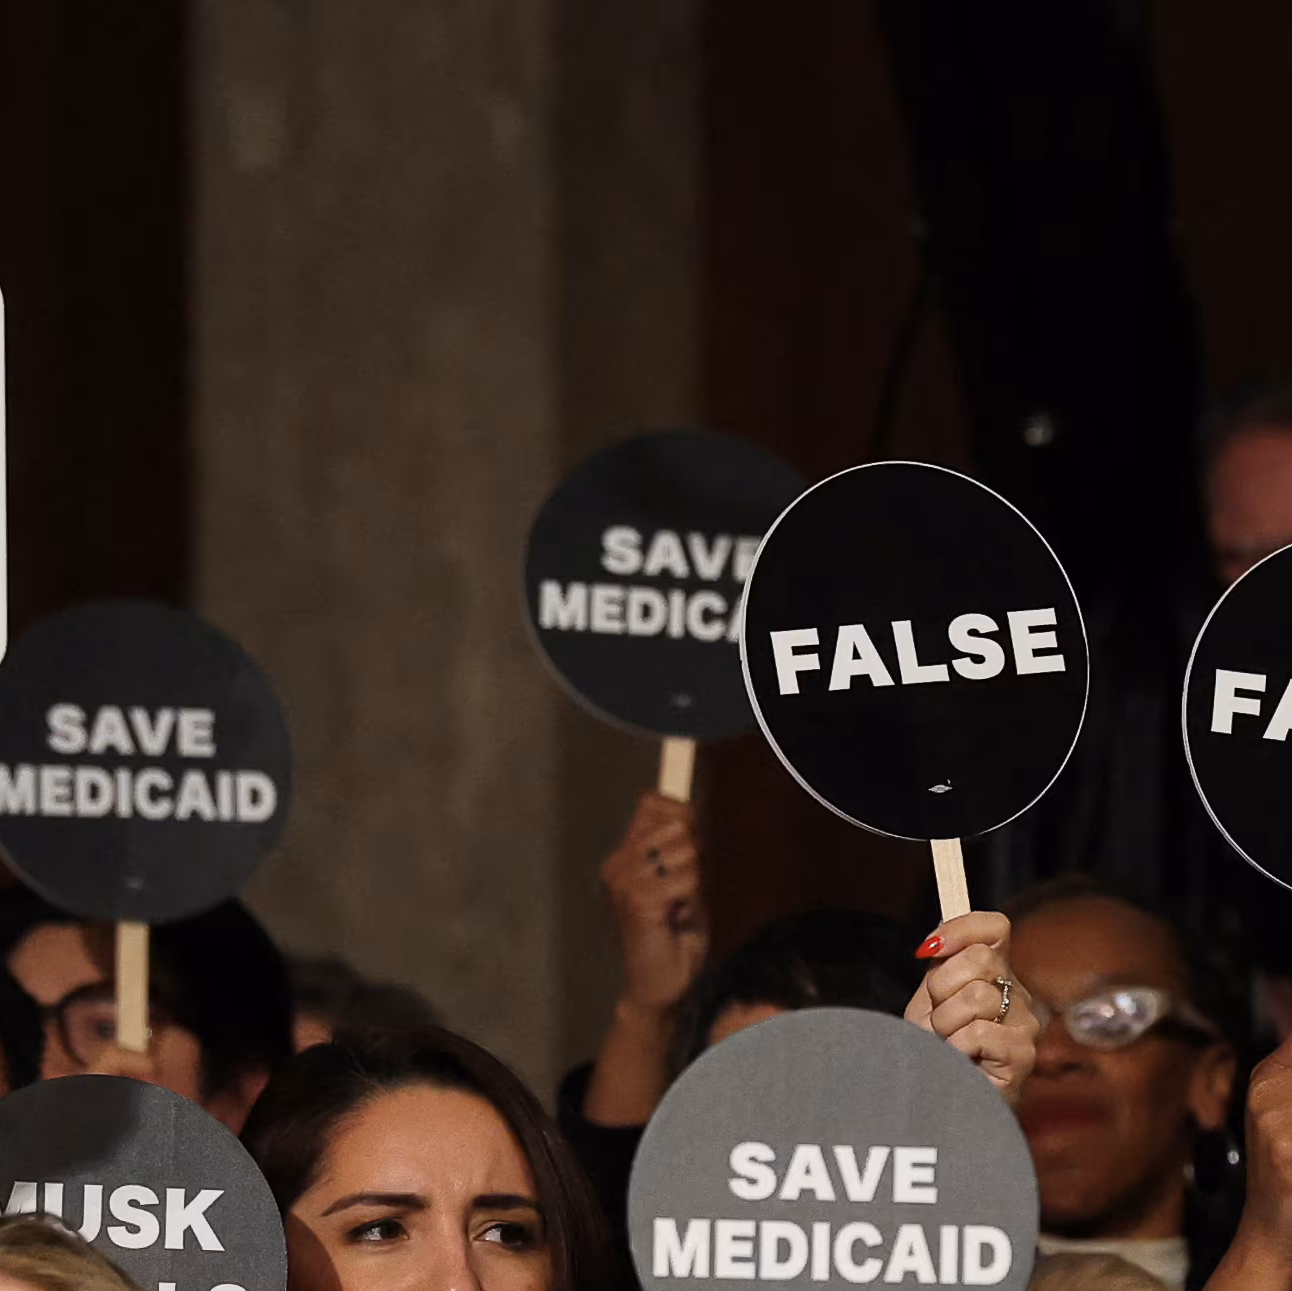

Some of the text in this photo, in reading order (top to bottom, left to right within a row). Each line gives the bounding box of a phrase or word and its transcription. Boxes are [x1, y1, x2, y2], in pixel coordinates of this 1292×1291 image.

[538, 579, 743, 644] MEDIC
[769, 607, 1066, 696] FALSE
[46, 702, 217, 758] SAVE
[727, 1141, 938, 1204] SAVE
[652, 1216, 1013, 1285] MEDICAID
